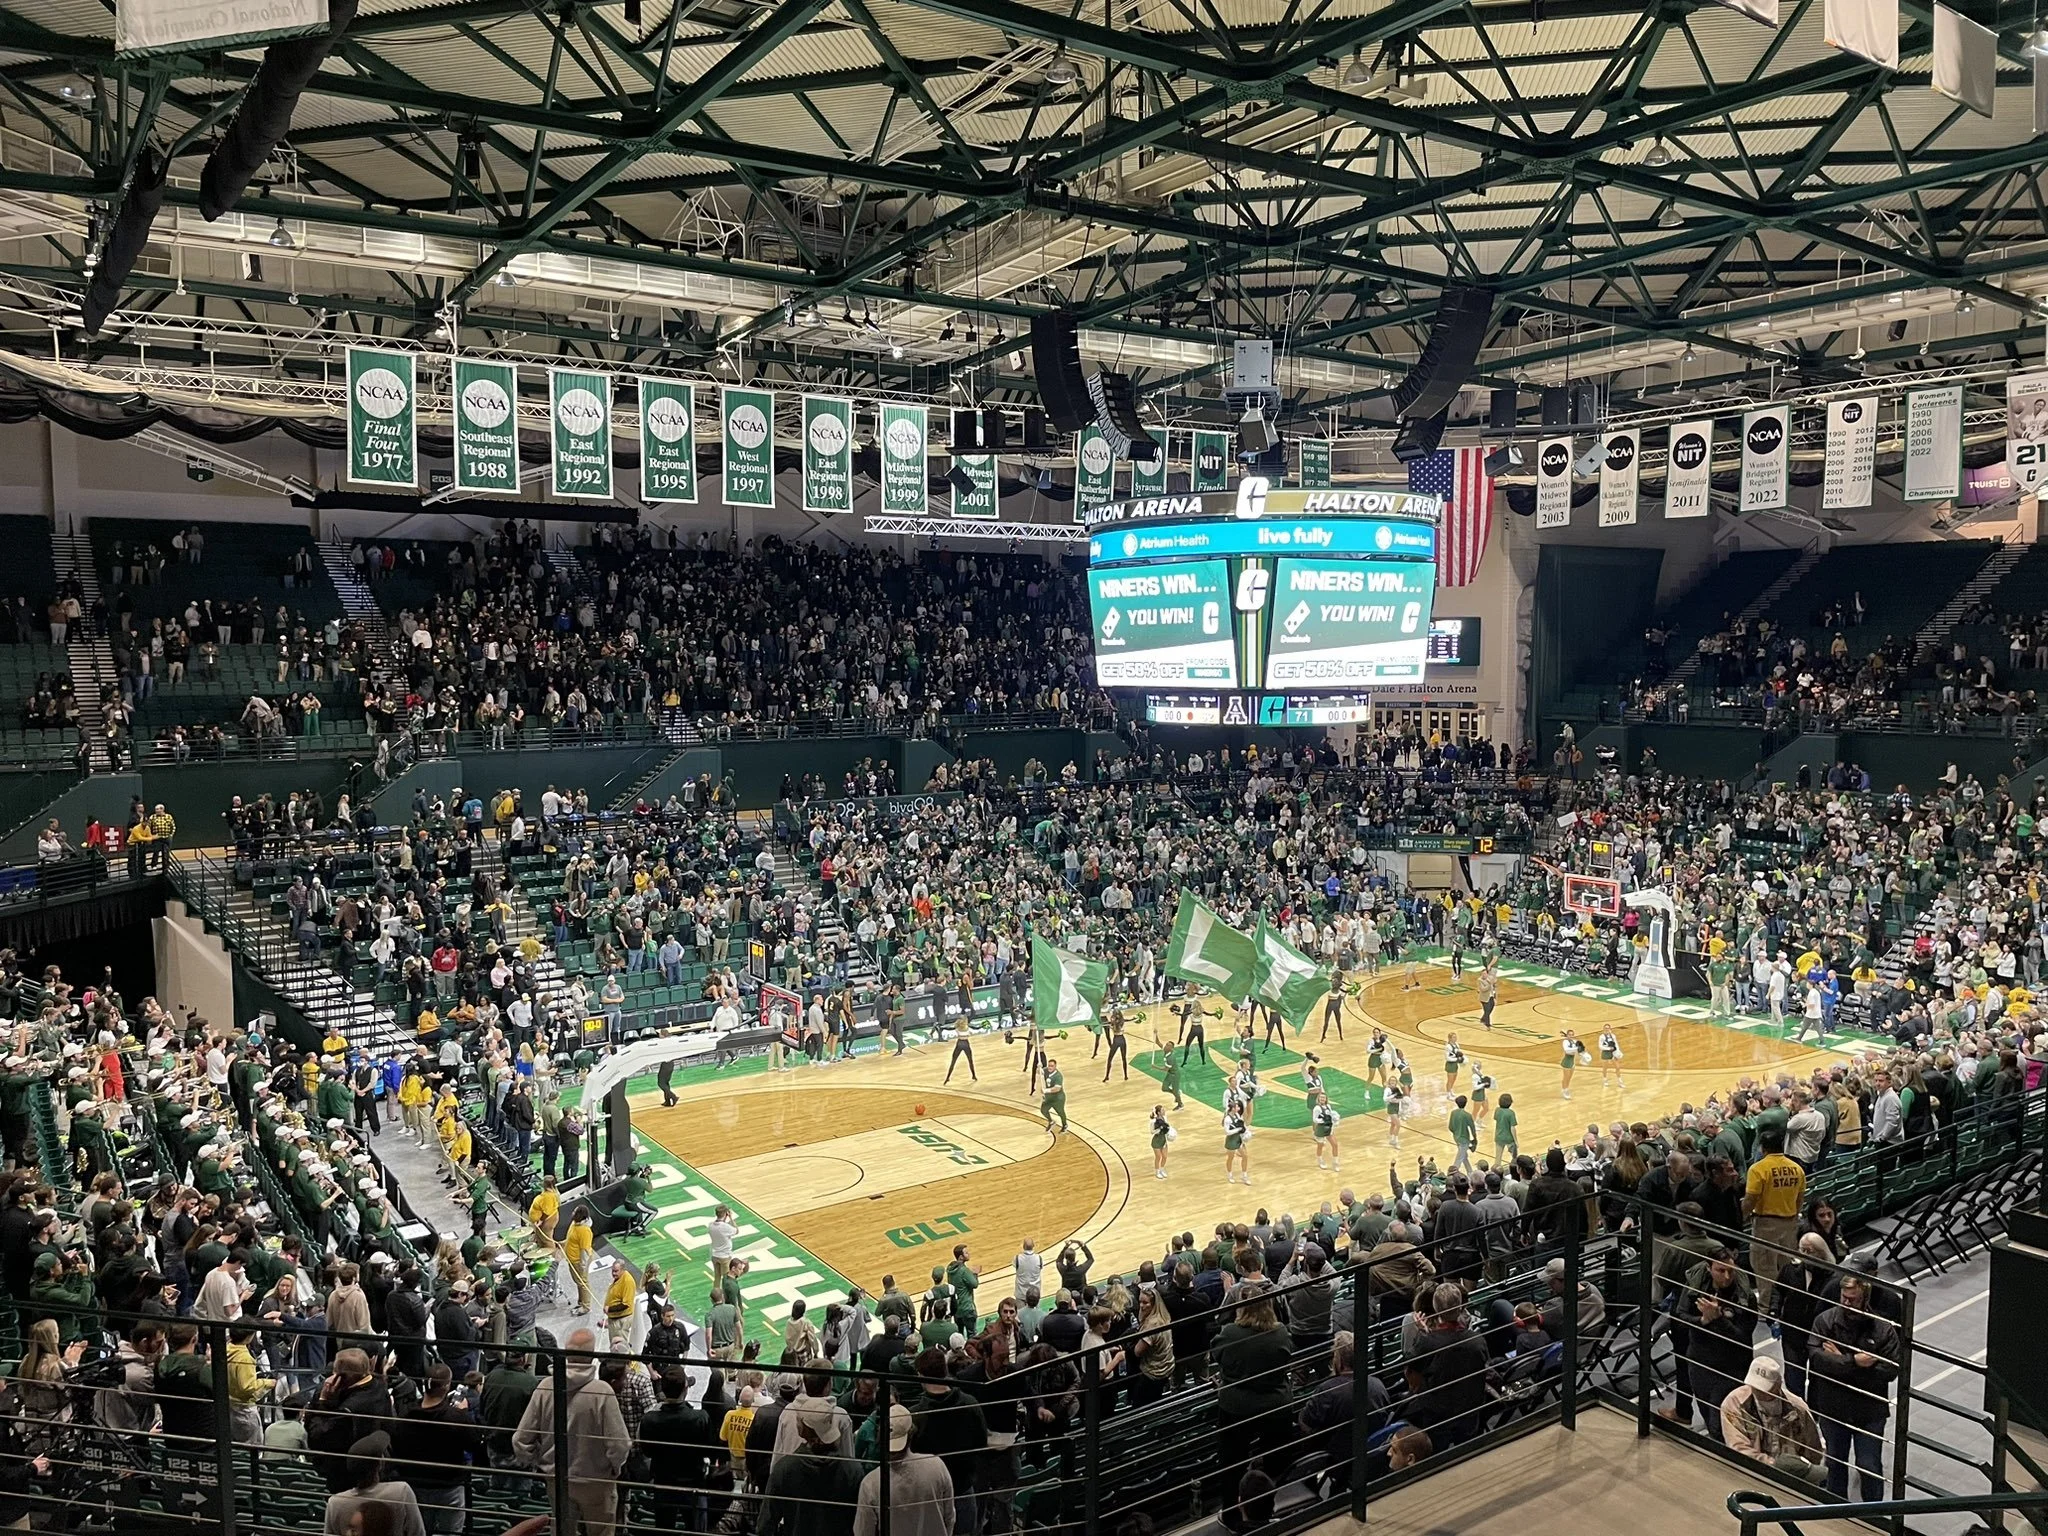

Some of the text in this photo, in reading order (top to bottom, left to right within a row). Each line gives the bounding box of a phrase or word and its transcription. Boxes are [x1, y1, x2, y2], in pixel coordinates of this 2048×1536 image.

[359, 385, 404, 401] NCAA
[1917, 390, 1953, 400] Women's
[465, 396, 506, 411] NCAA
[1912, 398, 1957, 409] Conference
[562, 404, 600, 419] NCAA
[1843, 411, 1860, 420] NIT
[1912, 410, 1932, 418] 1990
[650, 413, 685, 426] NCAA
[731, 419, 765, 433] NCAA
[1911, 419, 1932, 428] 2003
[363, 420, 401, 436] Final
[811, 428, 843, 441] NCAA
[1855, 426, 1874, 435] 2012
[1911, 429, 1932, 438] 2006
[460, 430, 514, 444] Southeast
[889, 432, 919, 445] NCAA
[1749, 429, 1782, 443] NCAA
[1828, 436, 1874, 448] 2004 2013
[1910, 438, 1932, 447] 2009
[365, 435, 399, 451] Four
[570, 438, 594, 450] East
[1678, 441, 1702, 450] Women's
[463, 443, 511, 458] Regional
[658, 445, 679, 457] East
[737, 450, 759, 462] West
[1084, 449, 1109, 461] NCAA
[1677, 448, 1703, 463] NIT
[1854, 446, 1873, 454] 2014
[1910, 448, 1931, 456] 2022
[2016, 442, 2047, 466] 21
[361, 452, 403, 470] 1977
[560, 451, 605, 465] Regional
[649, 457, 690, 471] Regional
[818, 458, 838, 469] East
[1200, 454, 1222, 469] NIT
[1542, 454, 1568, 467] NCAA
[1749, 459, 1779, 469] Women's
[468, 461, 508, 479] 1988
[728, 461, 768, 474] Regional
[886, 461, 922, 473] Midwest
[1852, 464, 1872, 472] 2019
[564, 468, 602, 484] 1992
[810, 470, 846, 482] Regional
[887, 473, 921, 486] Regional
[1088, 475, 1102, 485] East
[1745, 469, 1781, 479] Bridgeport
[1851, 474, 1871, 482] 2021
[653, 474, 687, 490] 1995
[732, 477, 764, 493] 1997
[1135, 482, 1163, 492] Syracuse
[1540, 480, 1569, 490] Women's
[1749, 476, 1778, 487] Regional
[1968, 479, 1998, 489] TRUIST
[812, 485, 843, 500] 1998
[890, 488, 919, 502] 1999
[1078, 484, 1110, 495] Rutherford
[1540, 491, 1568, 500] Midwest
[1825, 487, 1843, 495] 2010
[1908, 488, 1954, 498] Champions
[960, 493, 990, 507] 2001
[1081, 493, 1106, 503] Regional
[1672, 495, 1701, 508] 2011
[1747, 489, 1778, 504] 2022
[1824, 497, 1842, 505] 2011
[1131, 497, 1203, 518] ARENA
[1303, 492, 1442, 518] HALTON ARENA
[1540, 500, 1568, 511] Regional
[1542, 511, 1564, 524] 2003
[1605, 511, 1630, 524] 2009
[1139, 533, 1210, 549] Atrium Health
[1257, 527, 1334, 547] live fully
[1098, 573, 1217, 598] NINERS WIN...
[1290, 570, 1422, 593] NINERS WIN...
[1126, 607, 1194, 625] YOU WIN!
[1320, 604, 1396, 622] YOU WIN!
[1101, 663, 1124, 678] GET
[1159, 662, 1185, 678] OFF
[1273, 662, 1304, 678] GET
[1304, 660, 1345, 678] 50%
[1344, 660, 1374, 678] OFF
[1372, 683, 1477, 694] Dale F. Halton Arena
[1223, 696, 1248, 725] A
[1295, 710, 1348, 722] 71 00.0
[1480, 840, 1493, 852] 12
[1425, 983, 1474, 996] CLT
[917, 1006, 935, 1020] #1
[1771, 1166, 1798, 1177] EVENT
[1773, 1178, 1799, 1188] STAFF
[884, 1212, 972, 1248] CLT
[730, 1415, 751, 1426] EVENT
[730, 1424, 750, 1433] STAFF
